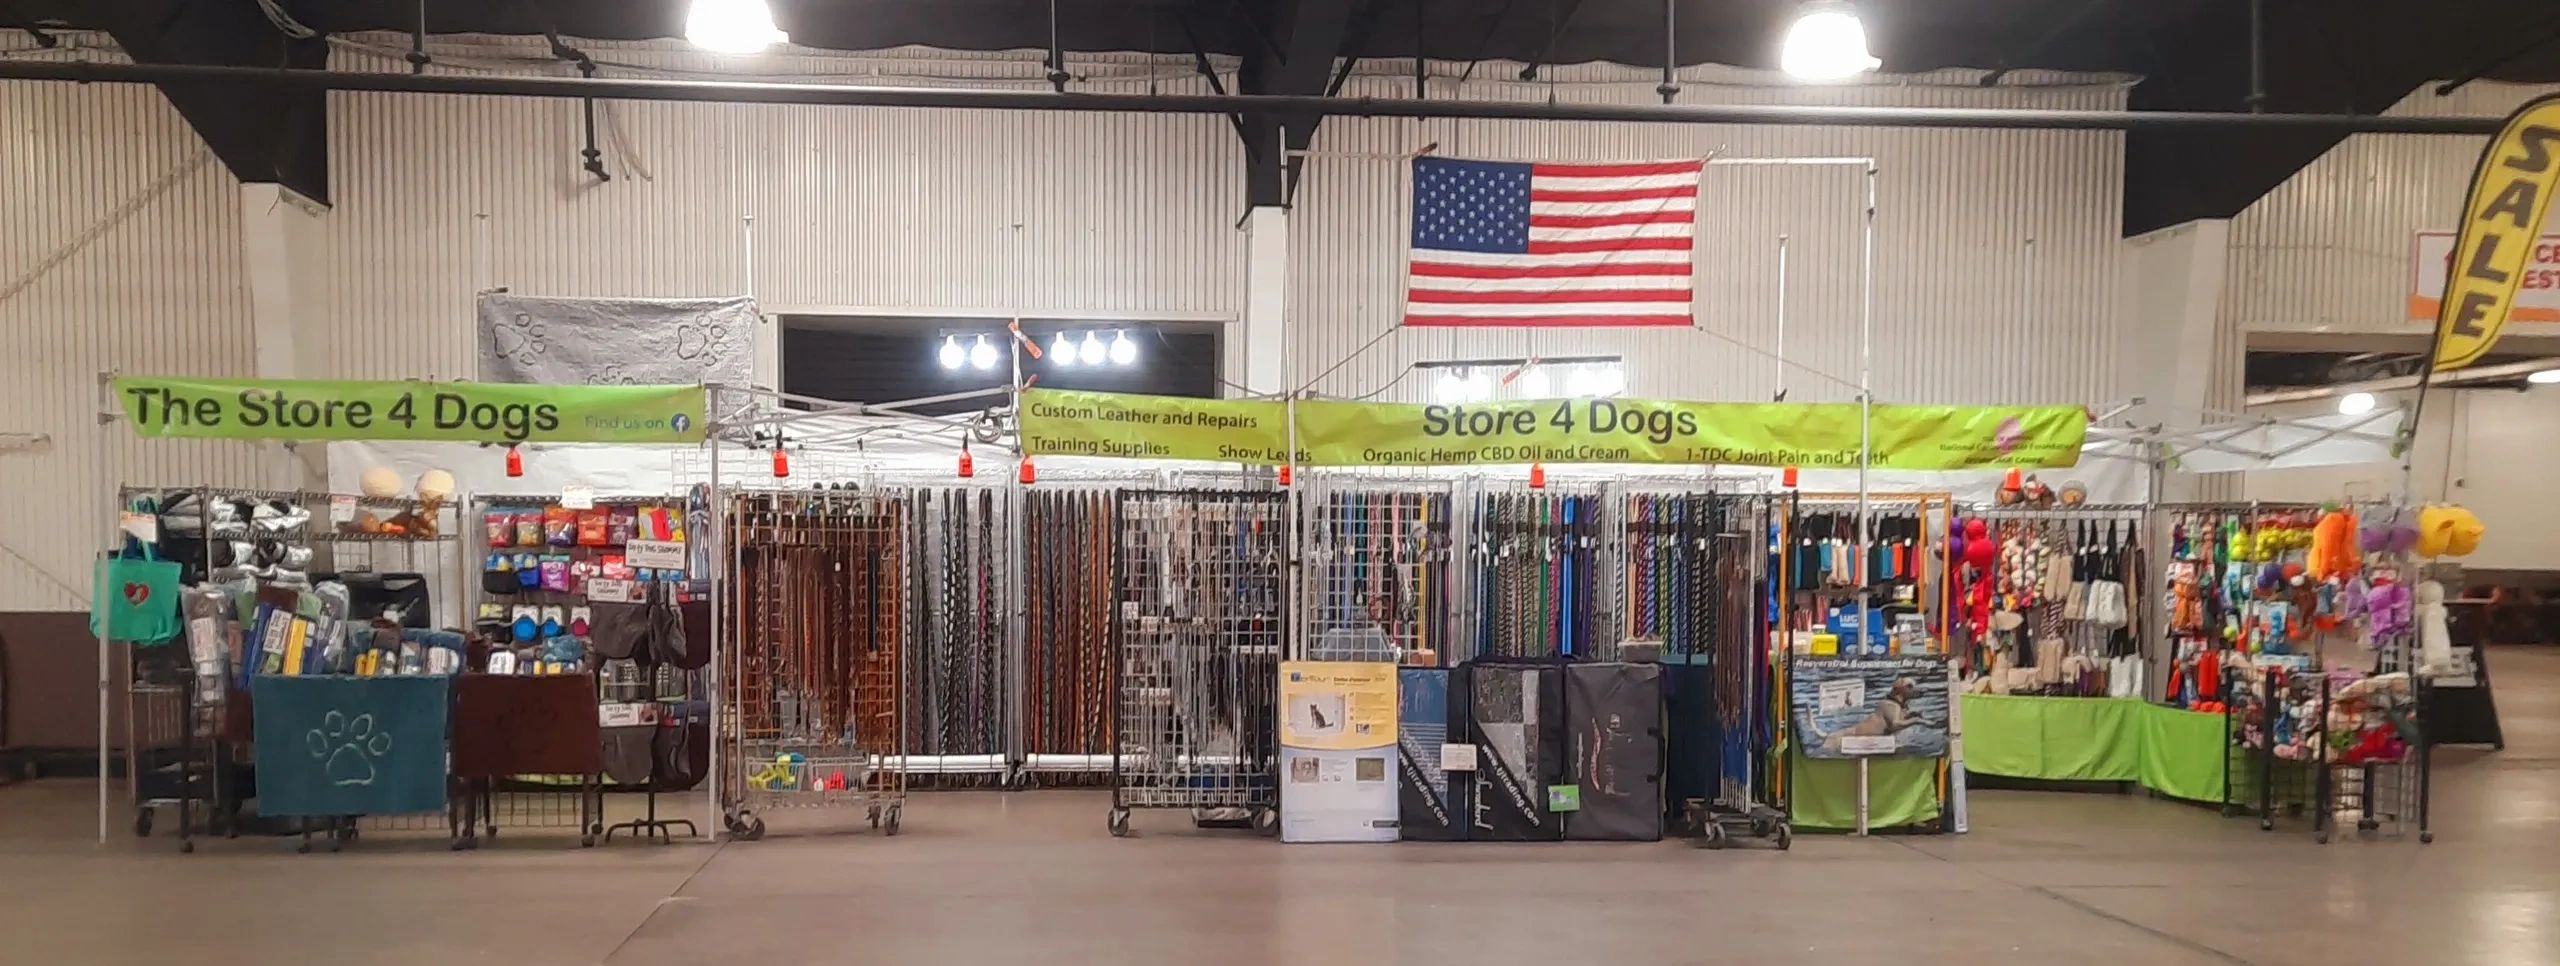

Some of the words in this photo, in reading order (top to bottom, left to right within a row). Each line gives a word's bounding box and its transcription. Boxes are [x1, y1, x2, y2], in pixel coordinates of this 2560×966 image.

[2451, 124, 2560, 338] SALE
[126, 388, 222, 426] The
[238, 388, 372, 428] Store
[387, 392, 416, 429] 4
[433, 393, 560, 441] Dogs
[584, 415, 619, 430] Find
[623, 418, 641, 430] us
[646, 418, 665, 430] on
[1031, 403, 1093, 420] Custom
[1097, 406, 1159, 424] Leather
[1162, 410, 1193, 426] and
[1198, 412, 1258, 430] Repairs
[1422, 405, 1536, 437] Store
[1549, 400, 1575, 433] 4
[1589, 400, 1698, 444] Dogs
[1032, 436, 1098, 455] Training
[1102, 439, 1170, 456] Supplies
[1218, 444, 1263, 460] Show
[1363, 447, 1426, 465] Organic
[1430, 447, 1477, 465] Hemp
[1480, 446, 1515, 461] CBD
[1519, 445, 1541, 460] Oil
[1545, 445, 1575, 460] and
[1578, 445, 1630, 460] Cream
[1737, 448, 1774, 464] Joint
[1778, 450, 1810, 465] Pain
[1814, 450, 1845, 465] and
